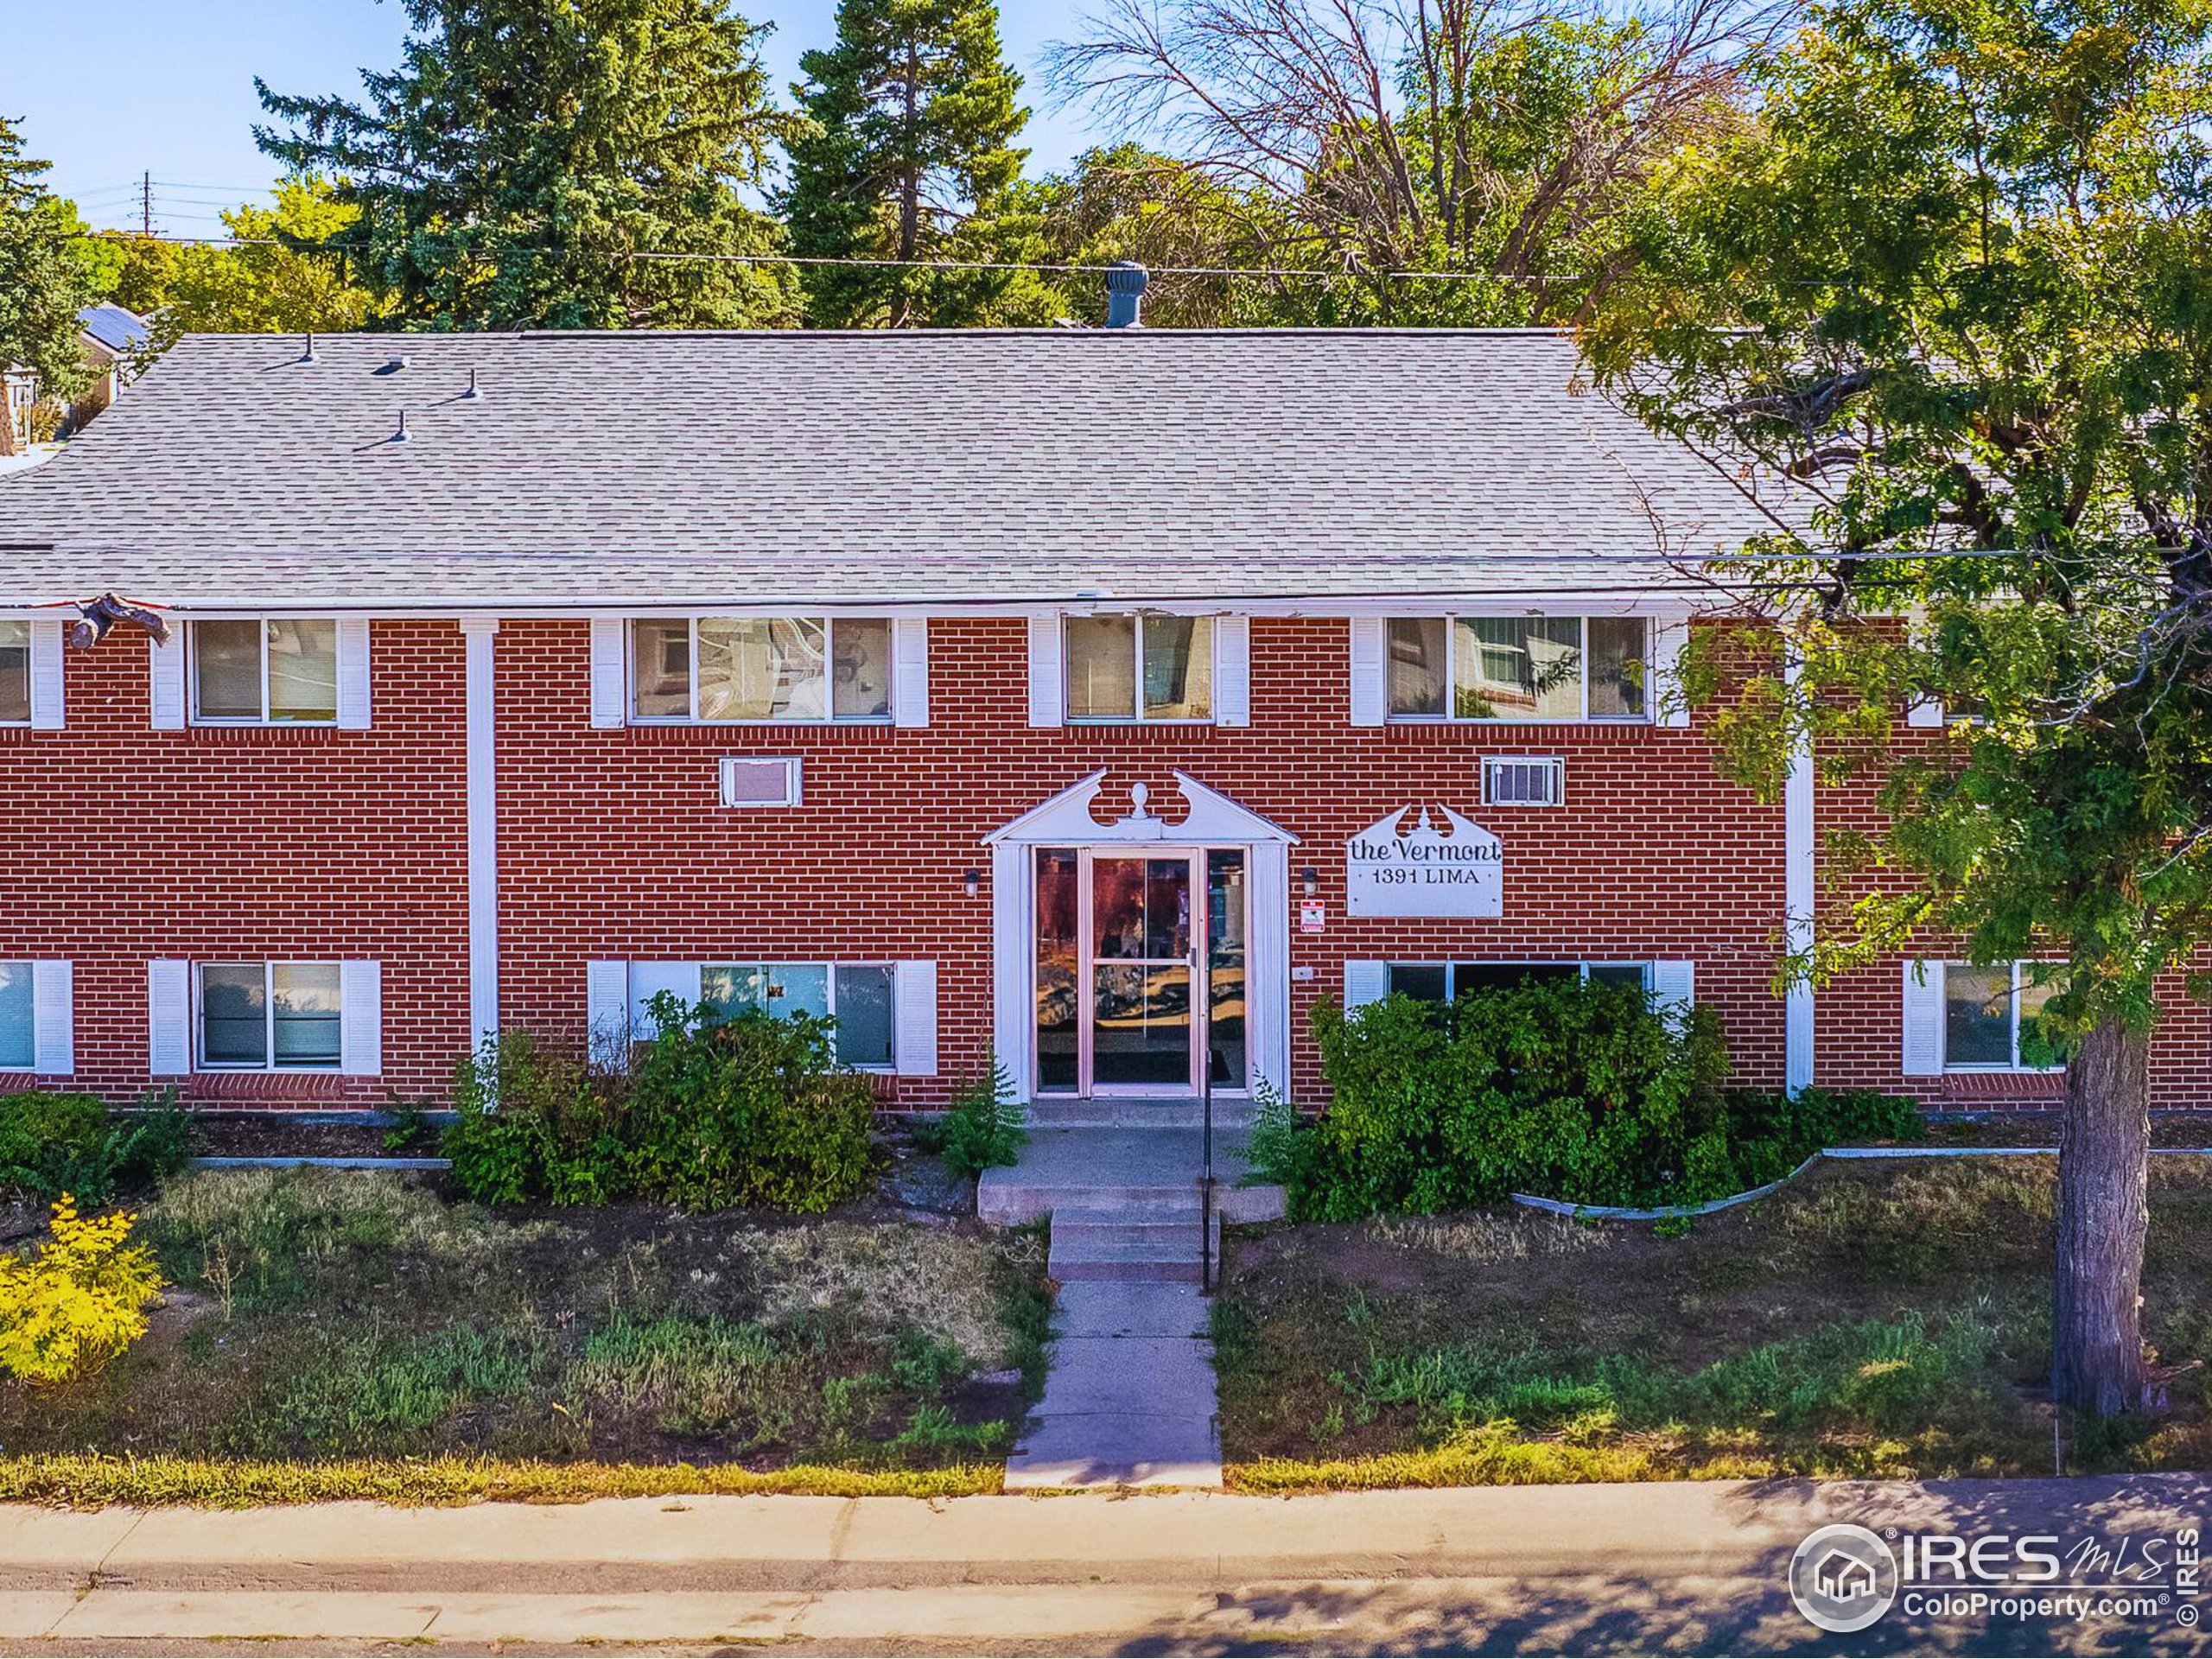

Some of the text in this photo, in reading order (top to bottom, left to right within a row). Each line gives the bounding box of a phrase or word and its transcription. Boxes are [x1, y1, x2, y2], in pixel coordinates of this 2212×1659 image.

[1349, 839, 1502, 861] the Vermont
[1372, 868, 1480, 884] 1391 LIMA
